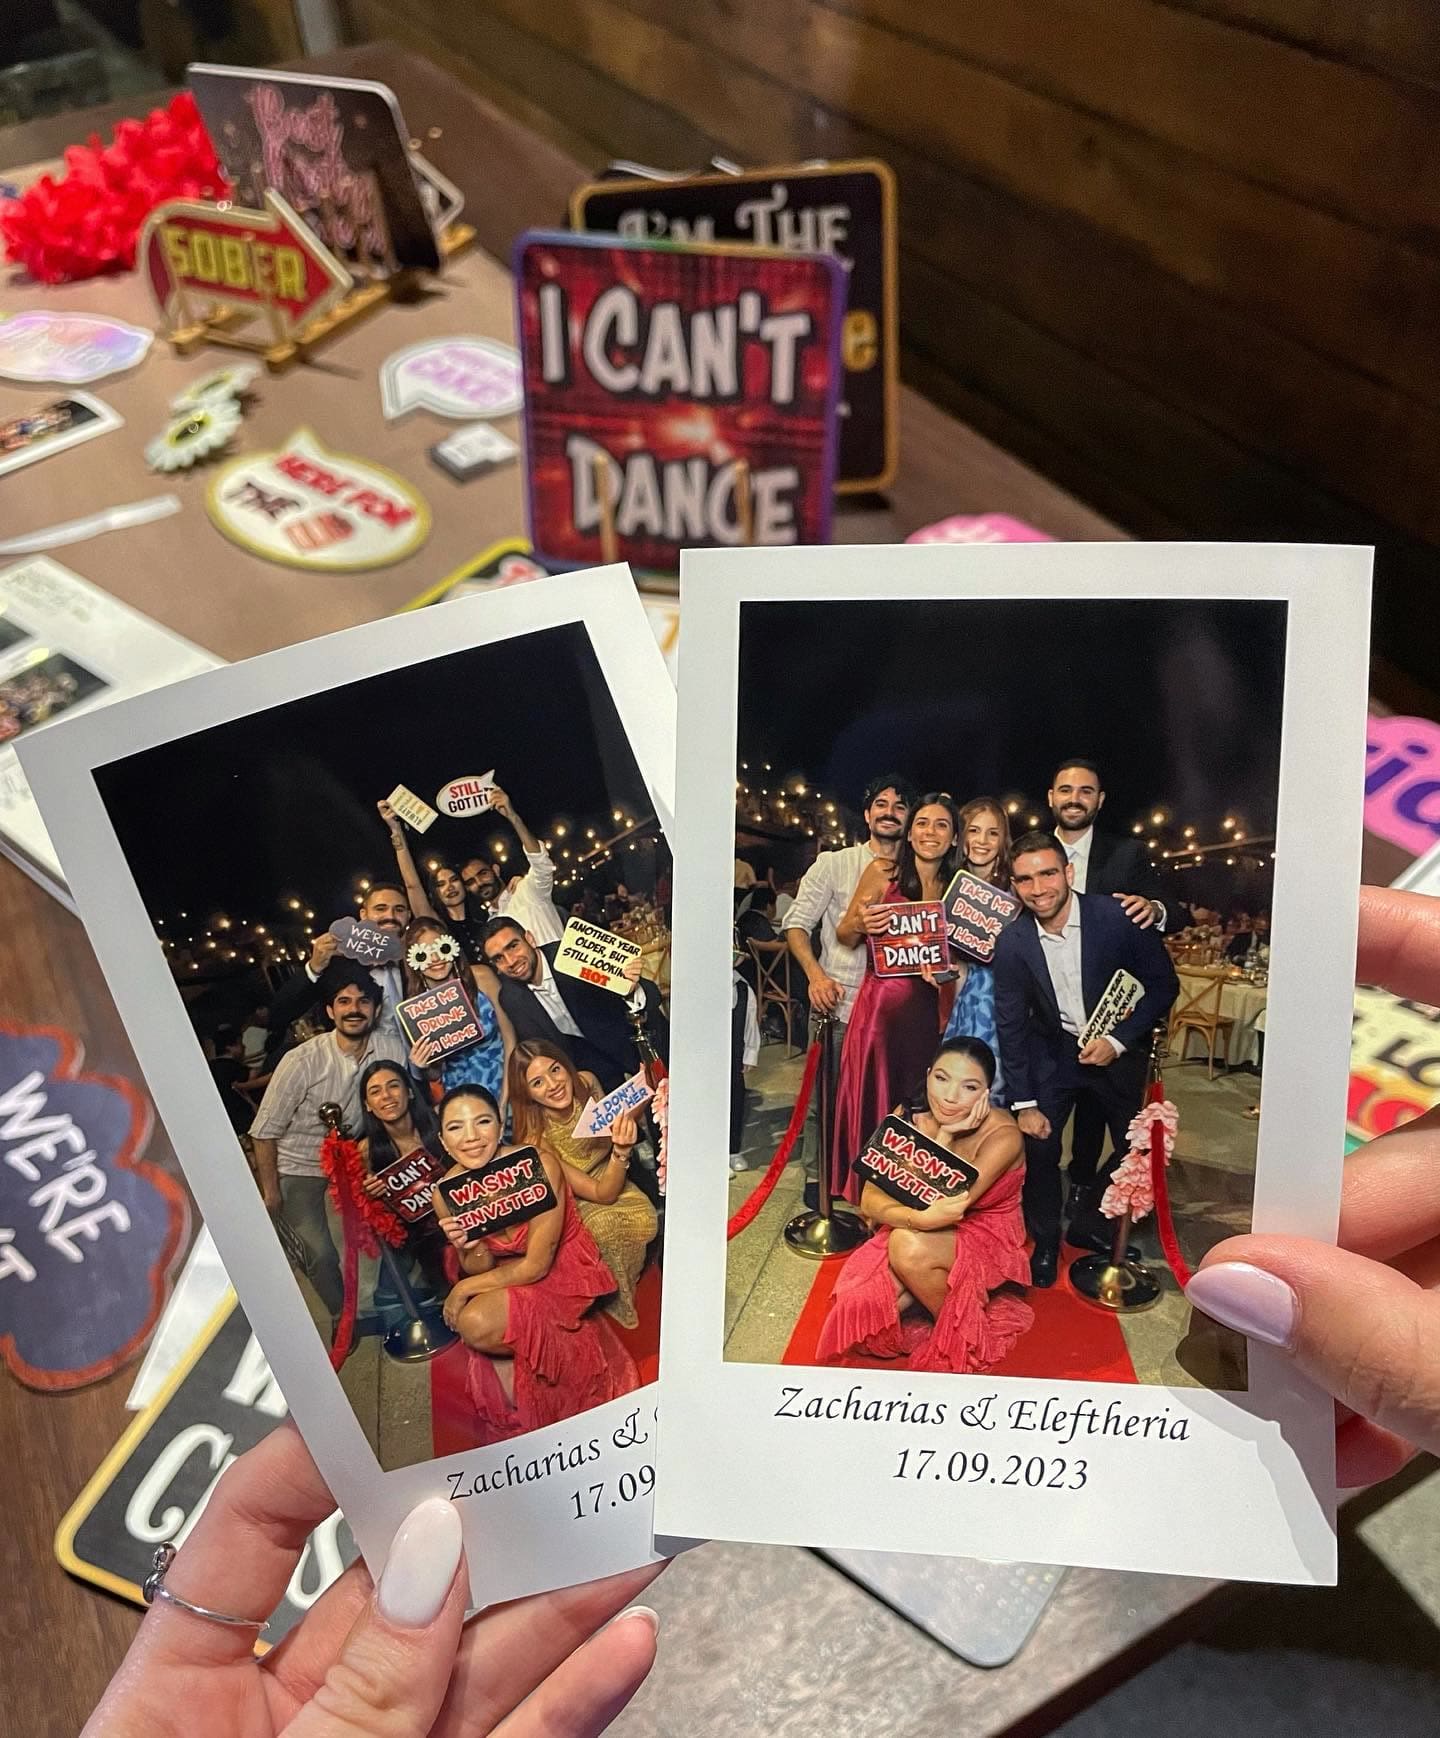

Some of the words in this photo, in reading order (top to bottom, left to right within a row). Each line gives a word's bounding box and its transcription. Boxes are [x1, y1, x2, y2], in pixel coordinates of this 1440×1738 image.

[734, 183, 855, 272] THE
[160, 226, 305, 301] SOBER
[539, 283, 566, 383] I
[582, 285, 812, 404] CAN'T
[566, 433, 799, 545] DANCE
[448, 800, 472, 813] GOT
[473, 794, 489, 808] IT!
[449, 781, 481, 799] STILL
[952, 897, 1003, 935] DRUNK
[959, 877, 993, 905] TAKE
[991, 895, 1015, 917] ME
[351, 924, 390, 946] WE'RE
[569, 921, 617, 946] ANOTHER
[616, 940, 641, 956] YEAR
[887, 910, 938, 936] CAN'T
[953, 926, 995, 956] HOME
[346, 938, 384, 959] NEXT
[562, 947, 589, 963] STILL
[590, 957, 625, 978] LOOKIN
[575, 936, 607, 958] OLDER,
[609, 950, 629, 964] BUT
[883, 945, 942, 967] DANCE
[579, 966, 611, 986] HOT
[404, 996, 438, 1020] TAKE
[436, 986, 460, 1006] ME
[1112, 986, 1126, 1008] BUT
[416, 1005, 467, 1036] DRUNK
[440, 1023, 478, 1050] HOME
[1082, 997, 1110, 1047] ANOTHER
[589, 1104, 622, 1135] KNOW
[626, 1087, 649, 1109] HER
[592, 1107, 603, 1120] I
[603, 1081, 636, 1113] DON'T
[0, 1070, 132, 1264] WE'RE
[388, 1157, 433, 1191] CAN'T
[861, 1146, 945, 1205] INVITE
[882, 1127, 967, 1189] WASN'T
[449, 1158, 533, 1207] WASN'T
[457, 1183, 548, 1231] INVITED
[773, 1385, 947, 1426] Zacharias
[960, 1393, 997, 1431] &
[1008, 1397, 1191, 1444] Eleftheria
[447, 1437, 601, 1501] Zacharias
[612, 1407, 649, 1449] &
[893, 1448, 1089, 1490] 17.09.2023
[571, 1464, 656, 1520] 17.09
